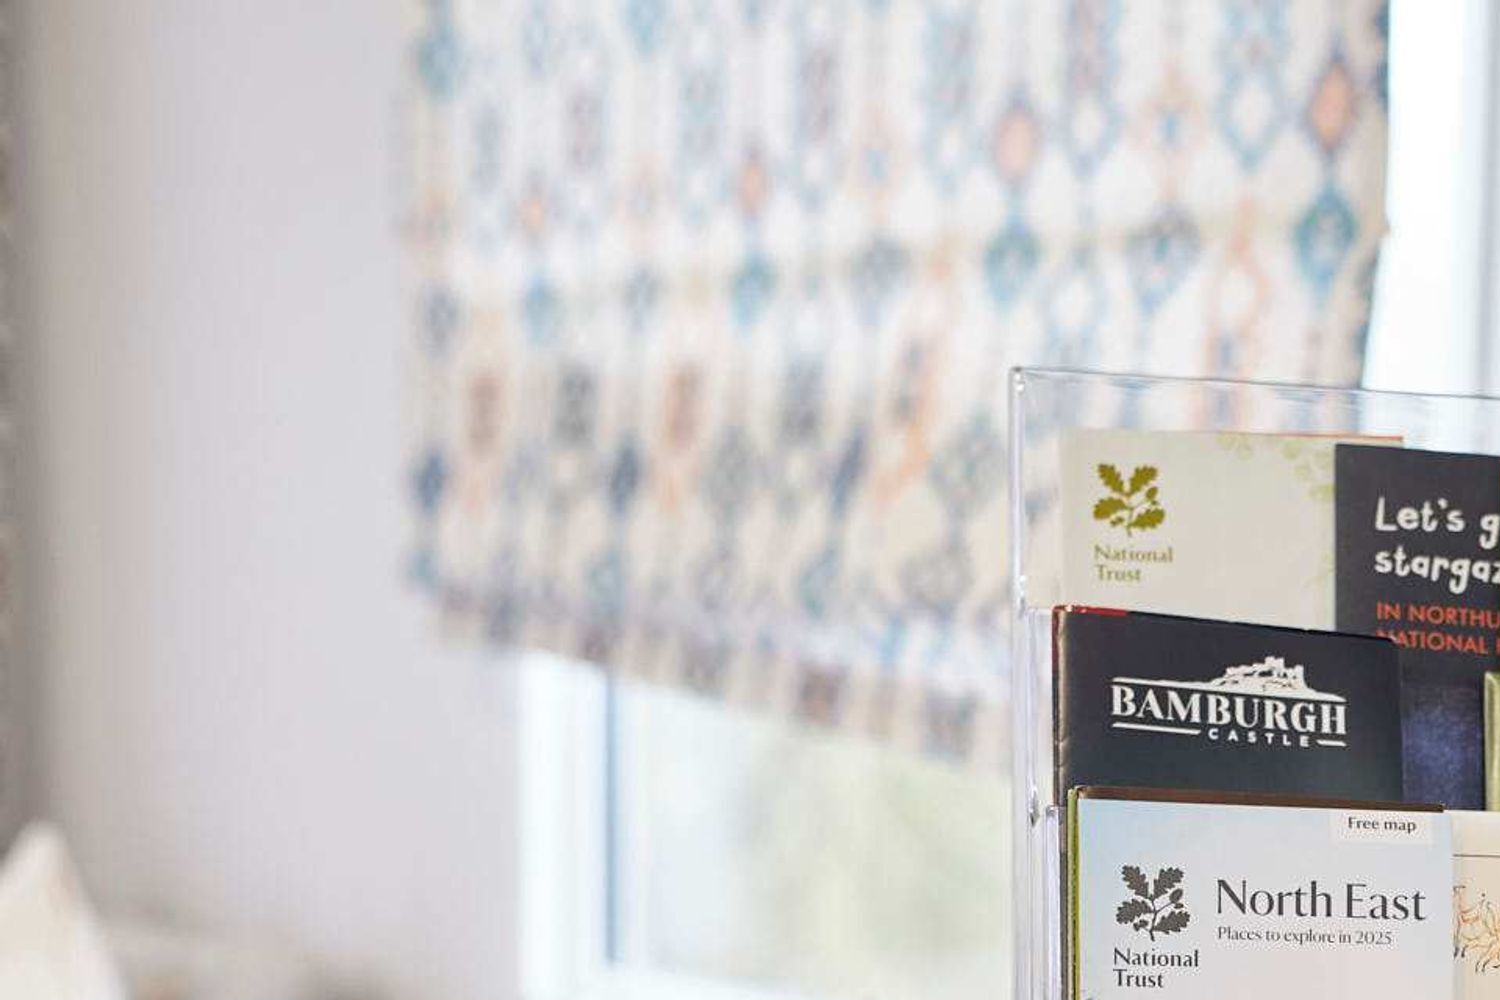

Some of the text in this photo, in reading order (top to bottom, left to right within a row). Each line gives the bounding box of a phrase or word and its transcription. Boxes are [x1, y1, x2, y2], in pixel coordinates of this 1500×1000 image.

[1375, 496, 1465, 532] Let's
[1094, 544, 1173, 562] National
[1095, 564, 1141, 581] Trust
[1376, 602, 1401, 620] IN
[1111, 684, 1348, 735] BAMBURGH
[1207, 728, 1310, 748] CASTLE
[1347, 816, 1417, 834] Free map
[1216, 879, 1427, 921] North East
[1217, 926, 1393, 946] Places to explore in 2025
[1113, 947, 1200, 968] National
[1112, 967, 1165, 989] Trust
